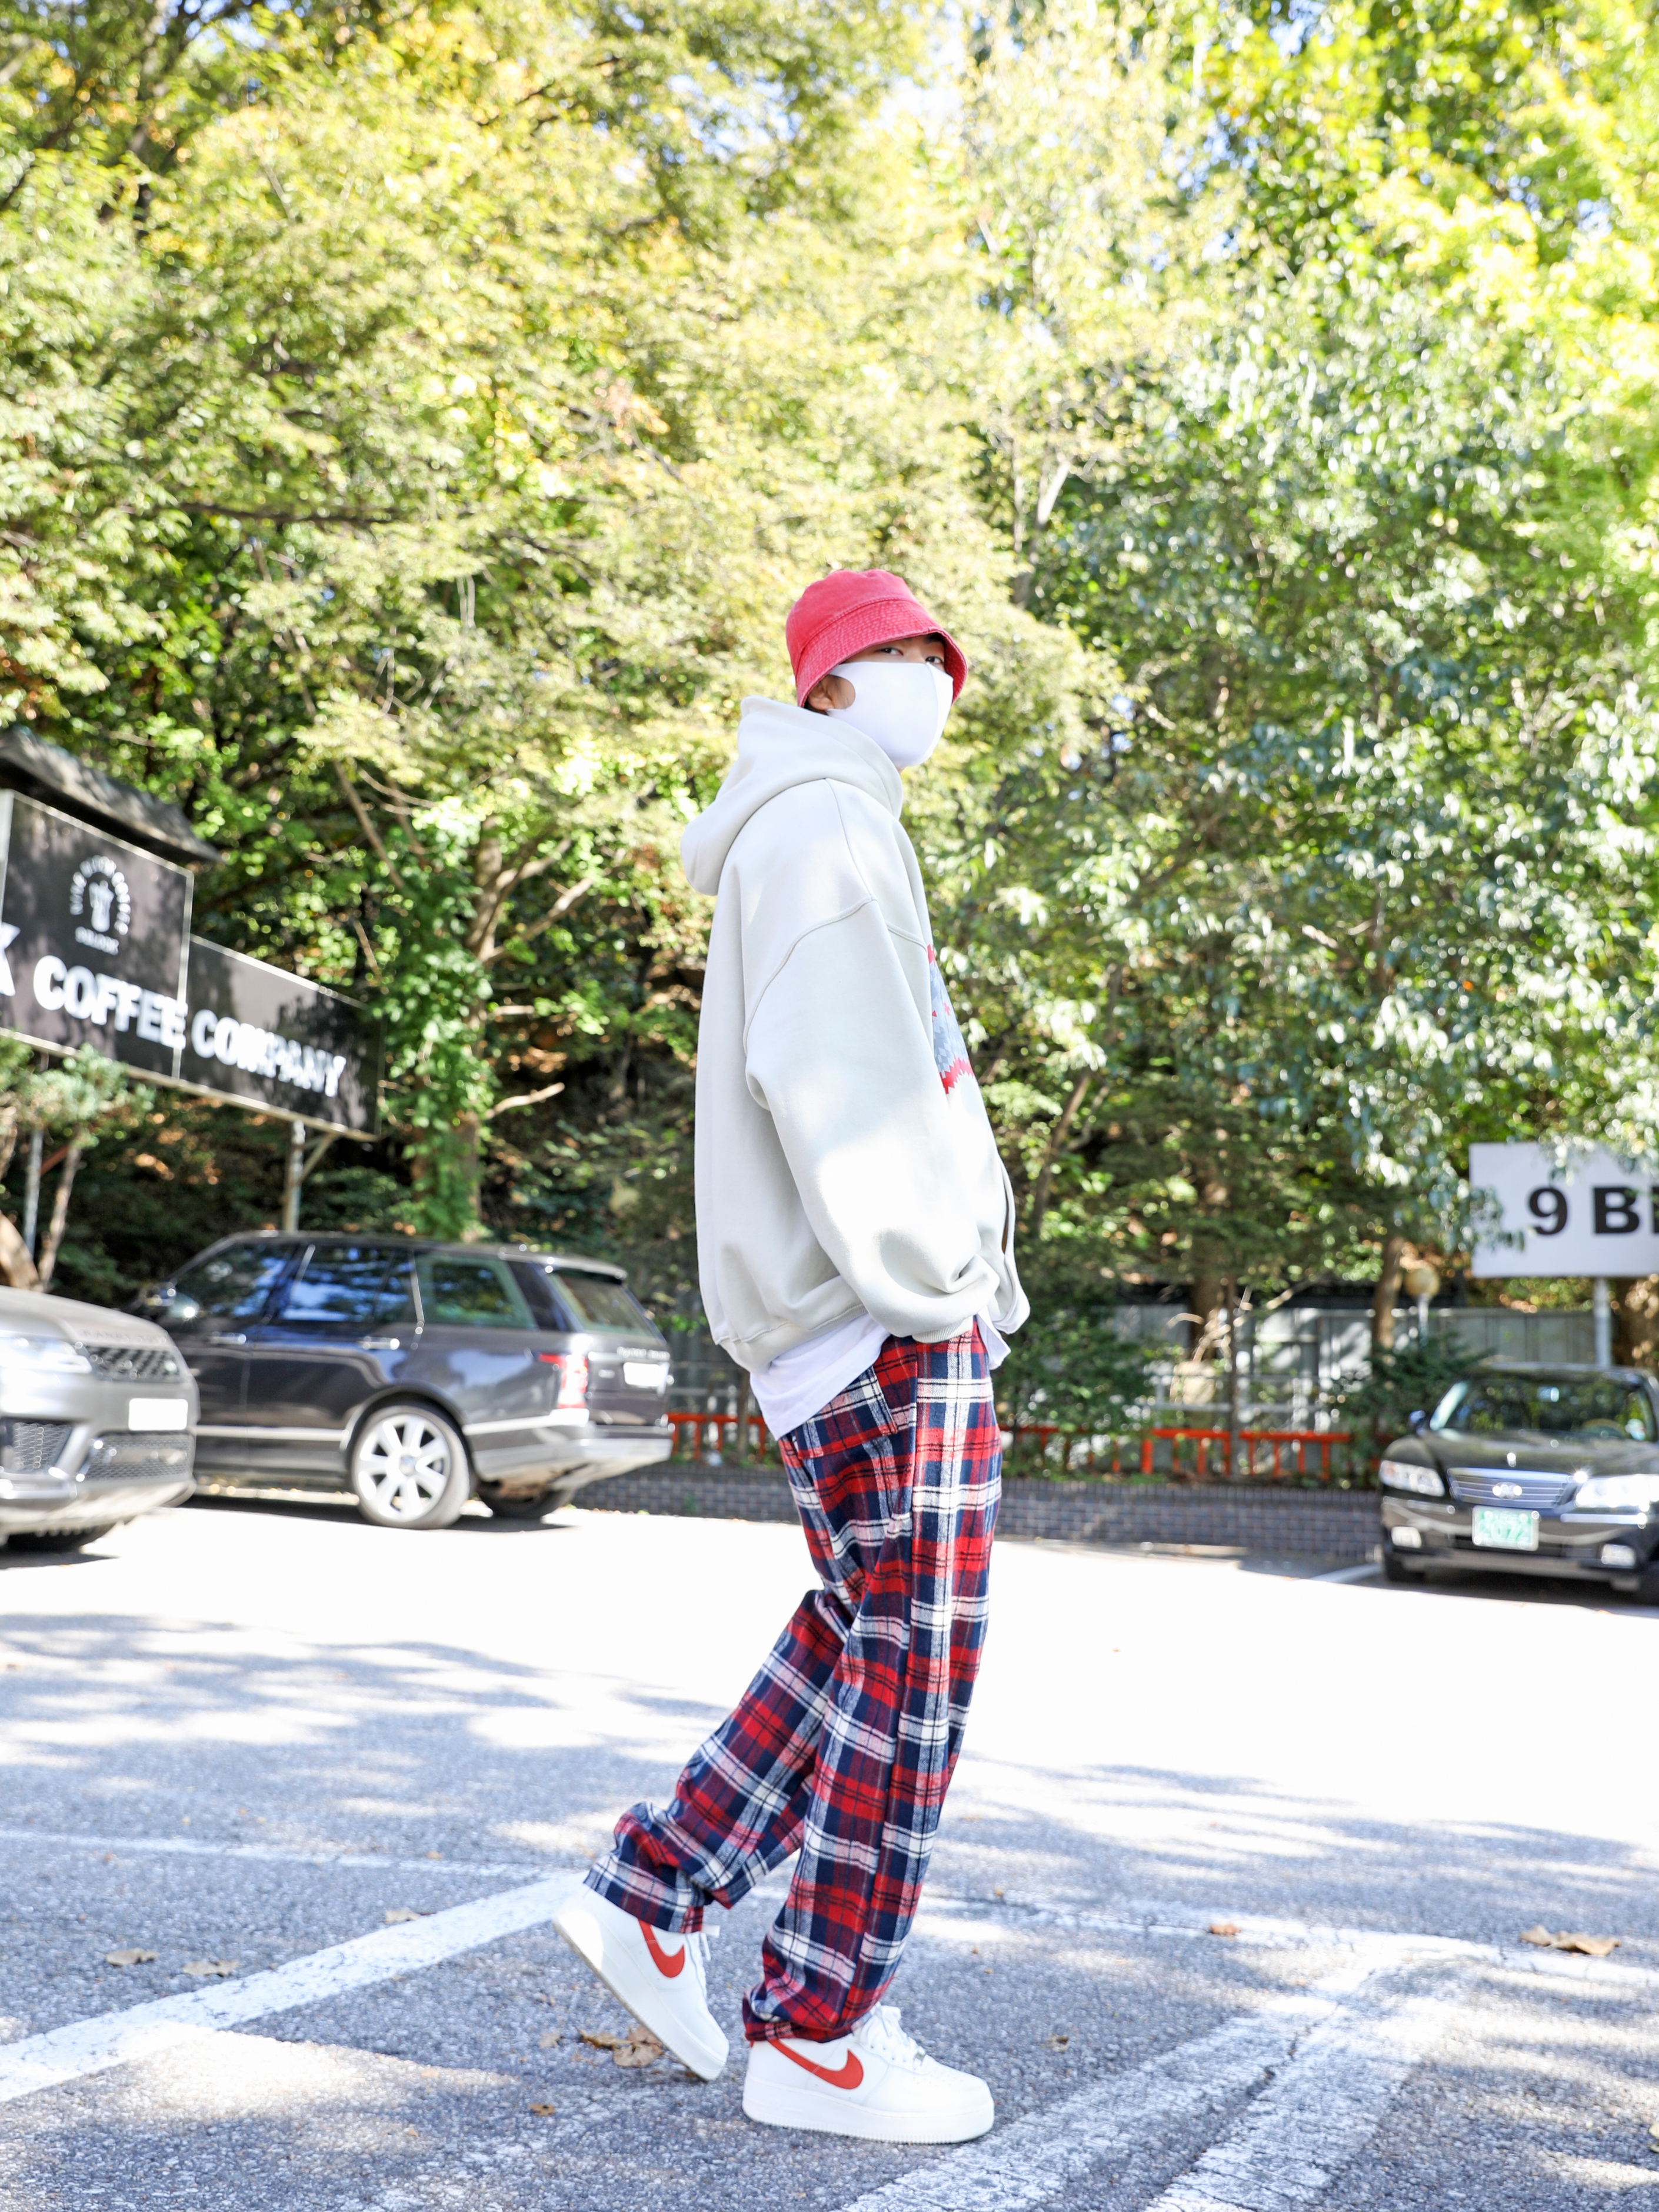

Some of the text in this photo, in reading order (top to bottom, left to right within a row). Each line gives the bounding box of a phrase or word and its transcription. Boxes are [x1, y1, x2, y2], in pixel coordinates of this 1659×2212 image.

[34, 955, 188, 1050] COFFEE
[191, 1009, 347, 1097] COMPANY
[1529, 1186, 1659, 1235] 9 B
